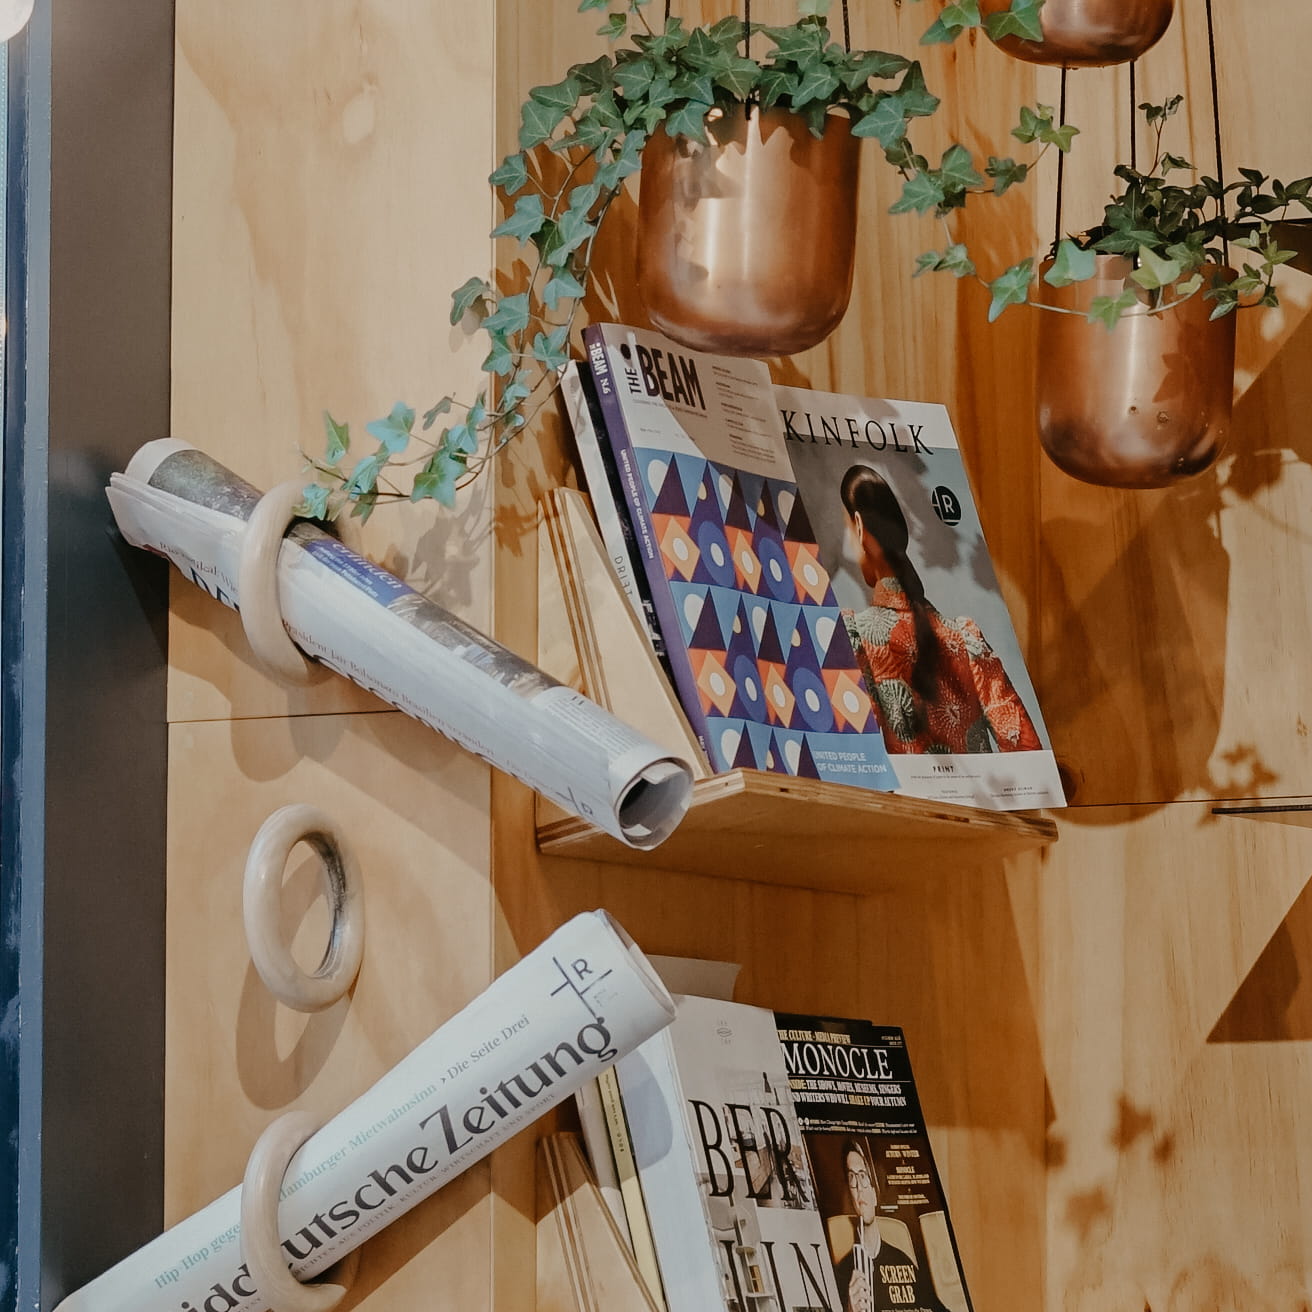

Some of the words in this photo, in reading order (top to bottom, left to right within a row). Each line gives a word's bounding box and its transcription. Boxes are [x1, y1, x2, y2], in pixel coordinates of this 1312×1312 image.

[624, 367, 643, 395] THE
[635, 344, 706, 410] BEAM
[780, 409, 934, 455] KINFOLK
[620, 449, 631, 473] UNITED
[627, 473, 639, 497] PEOPLE
[636, 507, 648, 535] CLIMATE
[643, 534, 654, 559] ACTION
[813, 750, 838, 761] UNITED
[838, 752, 867, 762] PEOPLE
[817, 763, 828, 772] OF
[828, 764, 858, 773] CLIMATE
[858, 764, 887, 774] ACTION
[780, 1042, 893, 1080] MONOCLE
[418, 1016, 618, 1155] Zeitung
[154, 1269, 180, 1289] Hip
[181, 1244, 211, 1272] Hop
[210, 1223, 241, 1253] gege
[349, 1083, 438, 1151] Mietwahnsinn
[447, 1060, 470, 1080] Die
[470, 1037, 501, 1064] Seite
[501, 1013, 531, 1040] Drei
[688, 1100, 811, 1204] BER
[880, 1264, 917, 1284] SCREEN
[889, 1285, 916, 1304] GRAB
